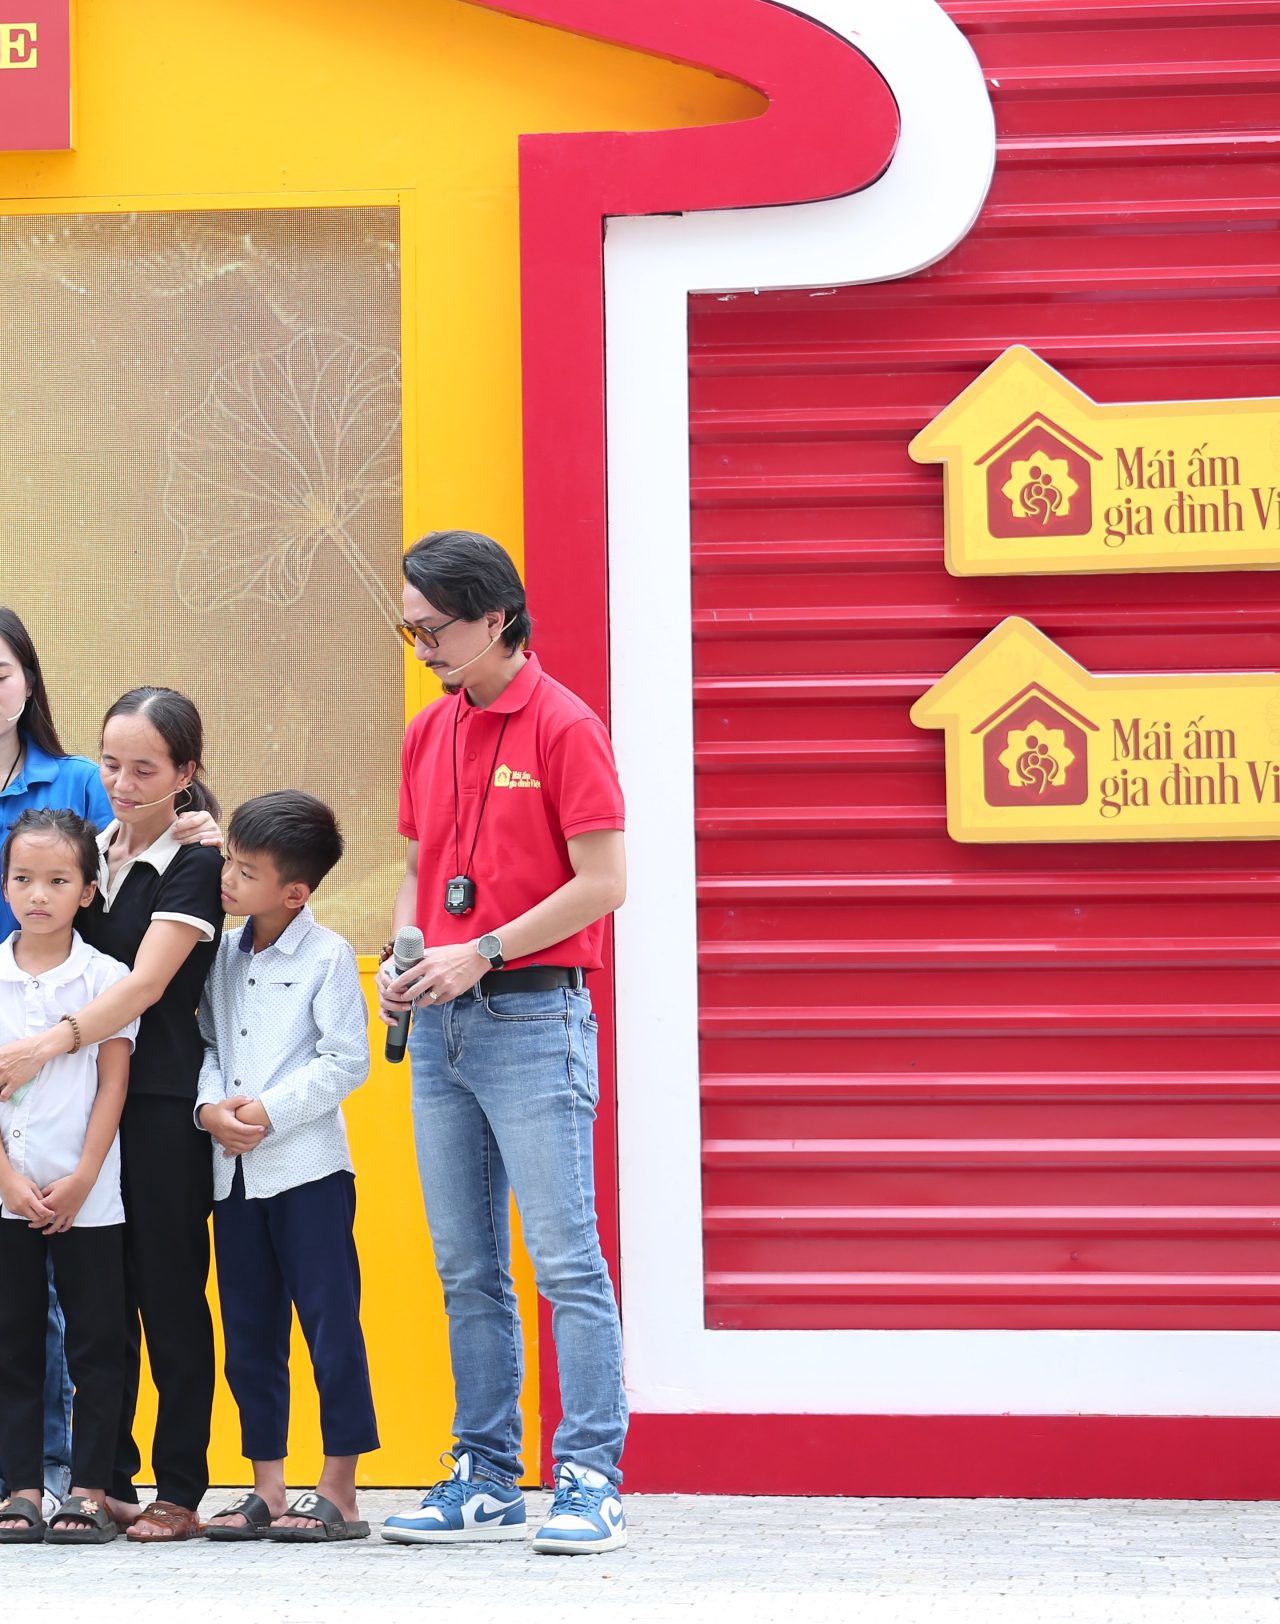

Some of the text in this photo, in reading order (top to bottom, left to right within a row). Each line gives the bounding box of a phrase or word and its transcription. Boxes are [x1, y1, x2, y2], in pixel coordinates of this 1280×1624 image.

[1114, 443, 1241, 490] Mái ấm
[1103, 498, 1154, 548] gia
[1164, 490, 1245, 534] đình
[1110, 715, 1237, 761] Mái ấm
[1099, 761, 1280, 818] gia đình Vi
